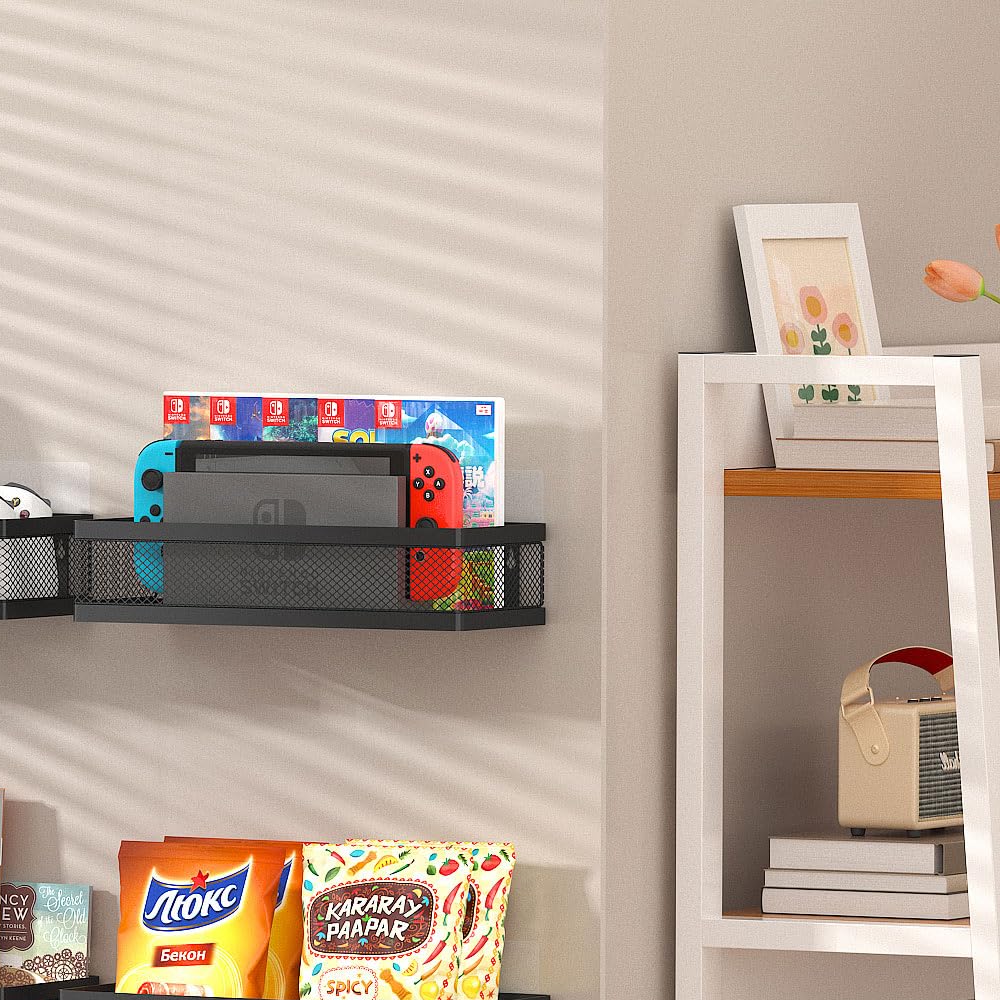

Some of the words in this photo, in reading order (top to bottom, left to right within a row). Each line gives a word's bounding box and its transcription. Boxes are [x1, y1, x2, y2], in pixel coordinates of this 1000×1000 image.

[0, 894, 29, 906] NCY
[39, 885, 55, 899] The
[43, 889, 84, 912] Secret
[2, 907, 29, 921] EW
[144, 885, 237, 924] Люкс
[325, 895, 423, 921] KARARAY
[56, 907, 86, 930] Old
[326, 917, 409, 941] PAAPAR
[43, 926, 87, 948] Clock
[160, 949, 207, 962] Бекон
[326, 979, 374, 996] SPICY
